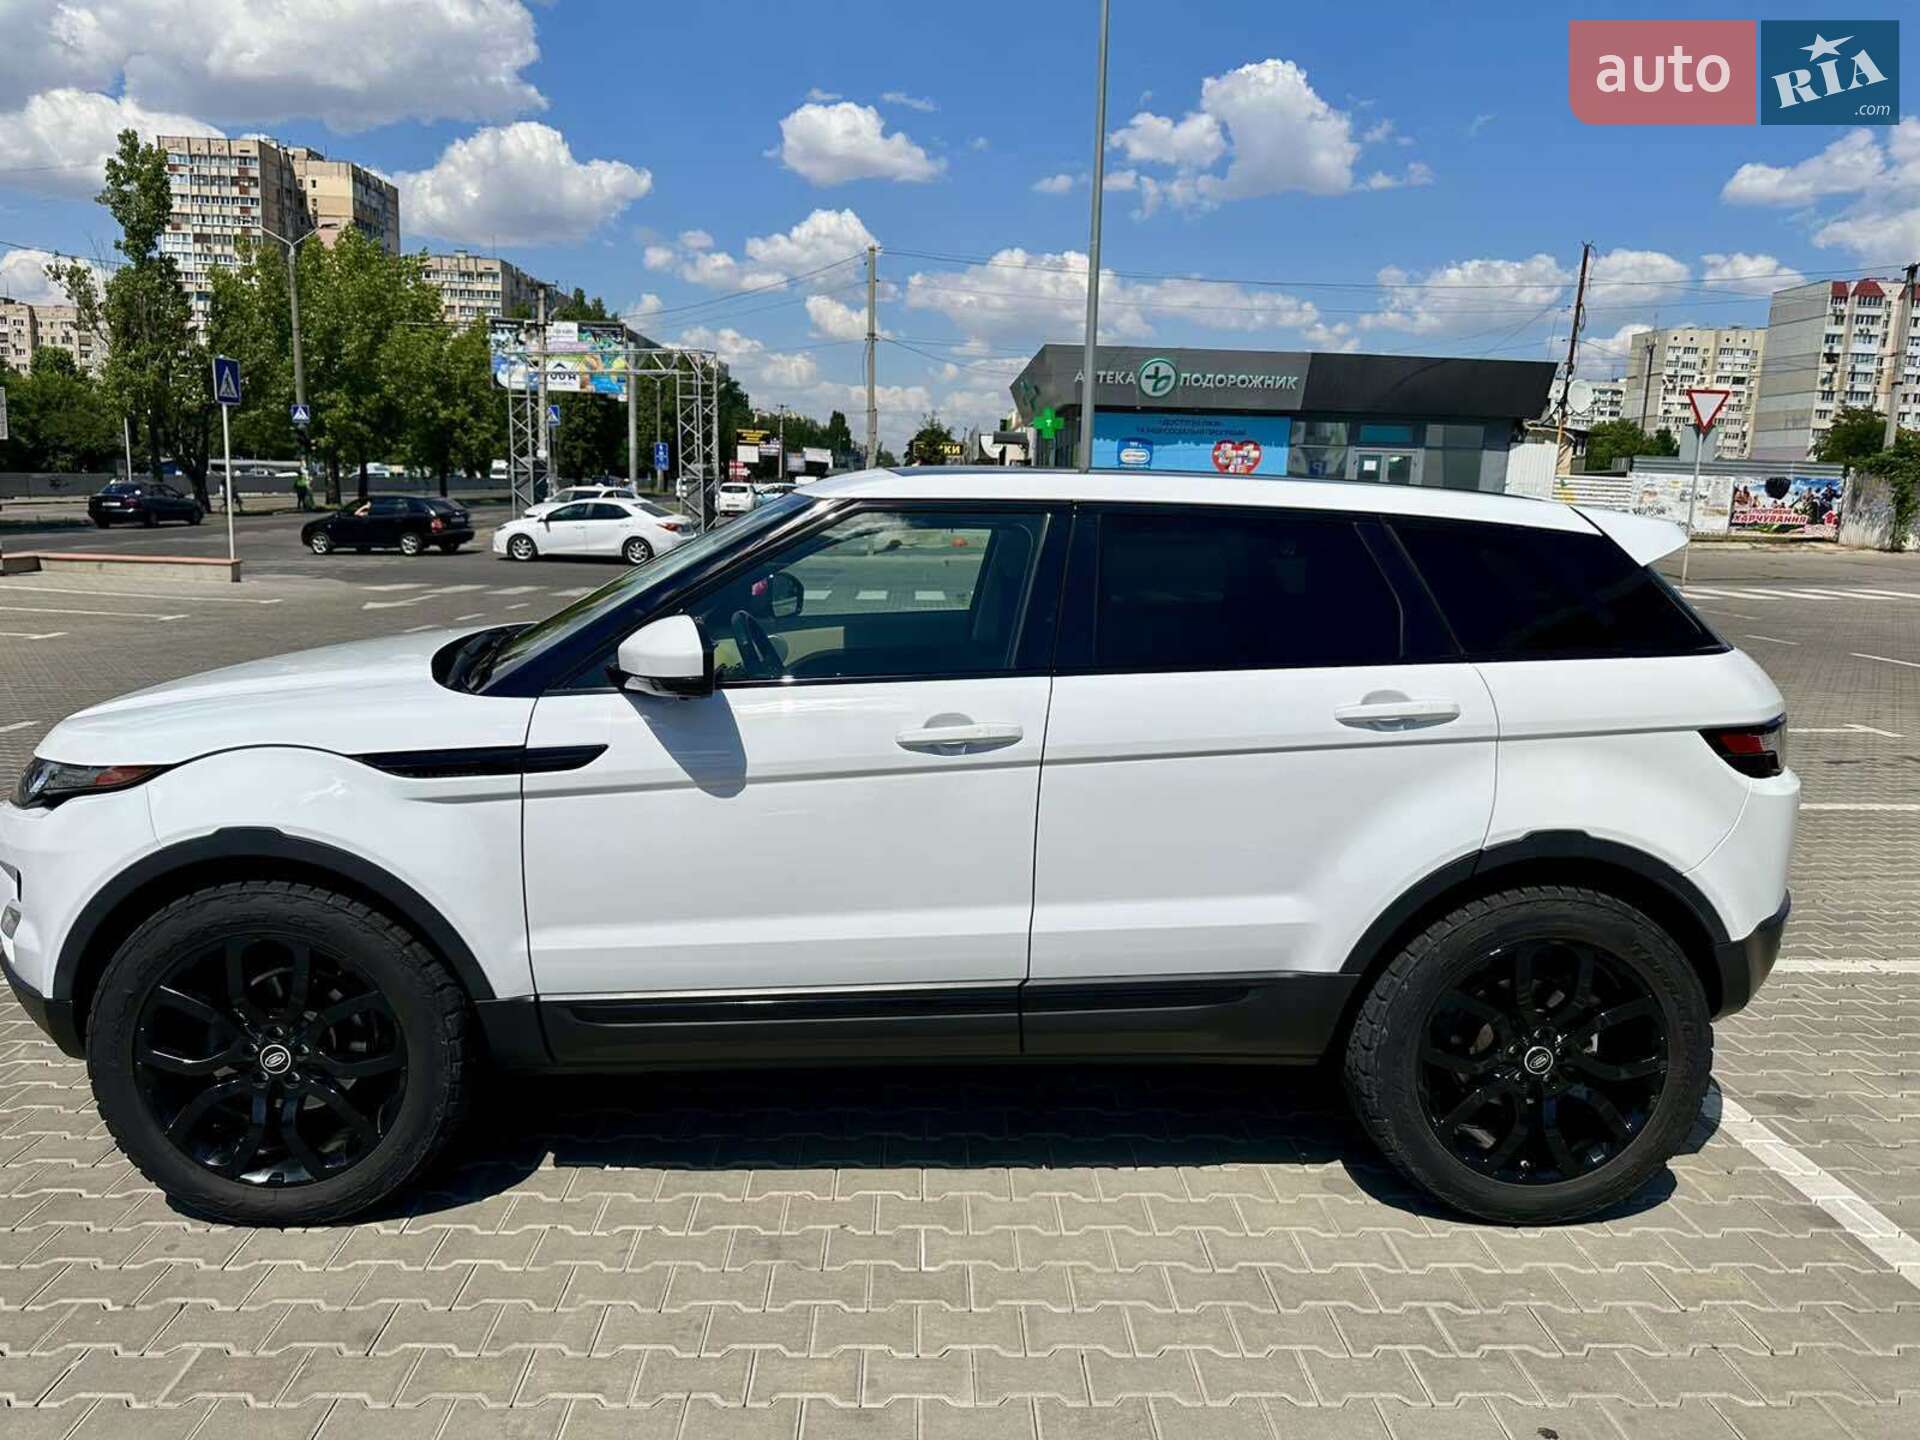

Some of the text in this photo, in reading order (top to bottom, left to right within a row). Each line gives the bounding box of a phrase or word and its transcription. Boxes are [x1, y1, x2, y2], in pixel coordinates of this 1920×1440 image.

[1074, 370, 1299, 390] АТЕКА ПОДОРОЖНИК
[1733, 514, 1807, 524] ХАРЧУВАННЯ
